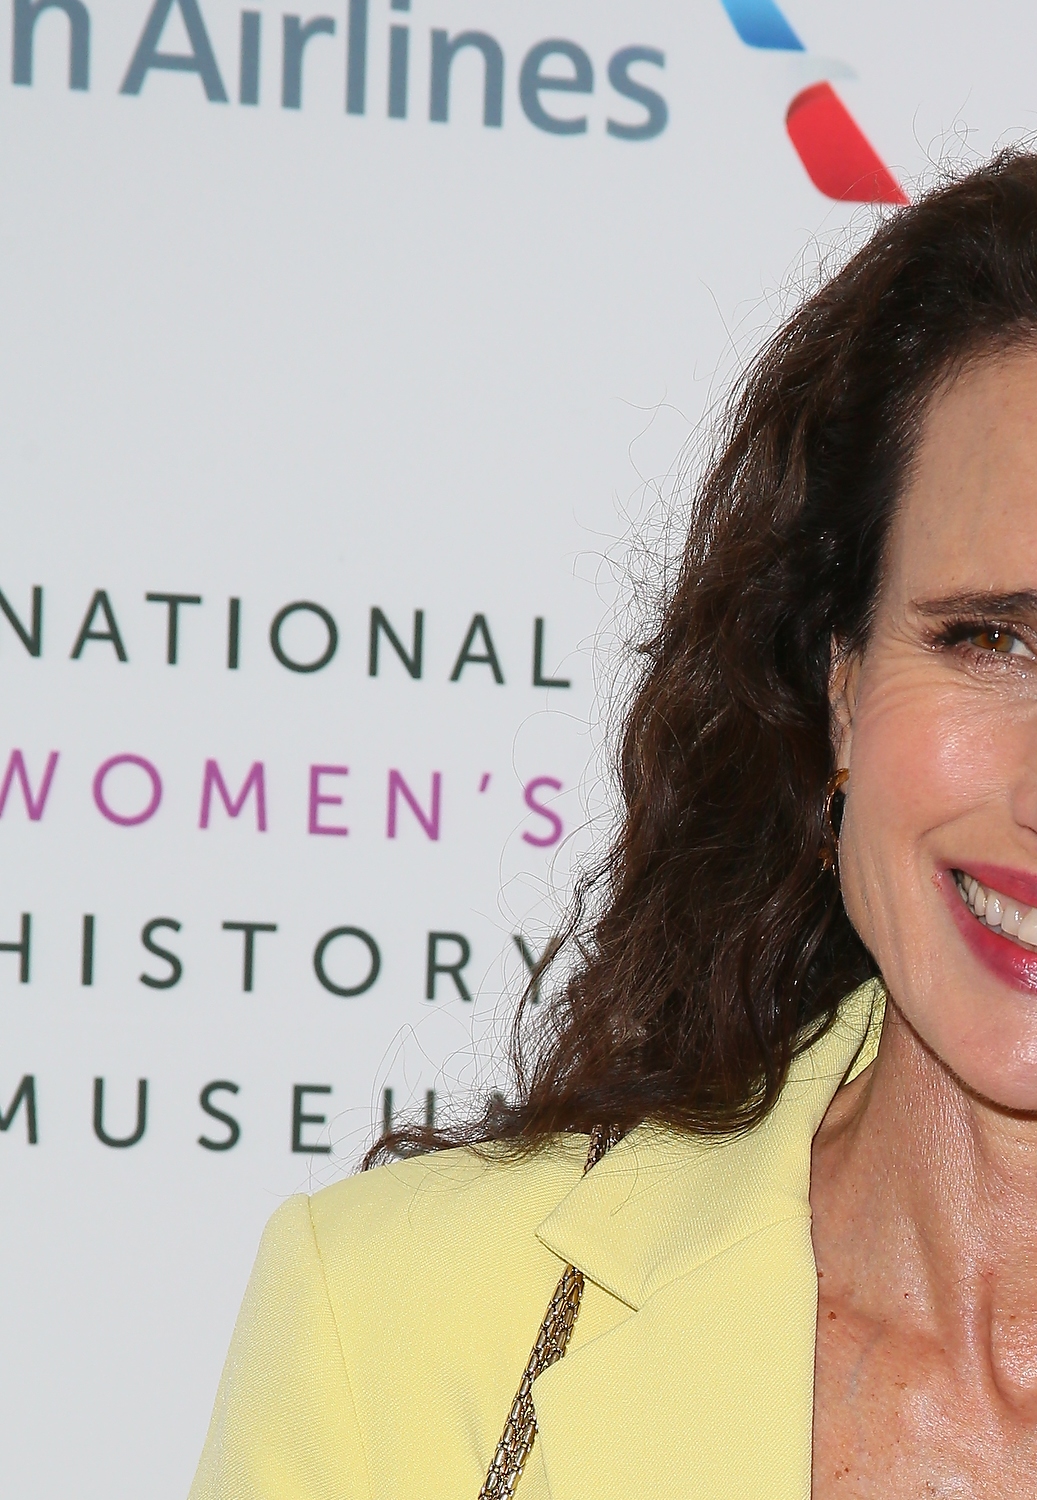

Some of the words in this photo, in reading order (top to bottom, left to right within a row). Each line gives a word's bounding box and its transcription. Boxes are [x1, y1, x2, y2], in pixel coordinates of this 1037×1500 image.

[120, 0, 669, 141] Airlines
[0, 585, 571, 689] NATIONAL
[0, 749, 563, 848] WOMEN'S
